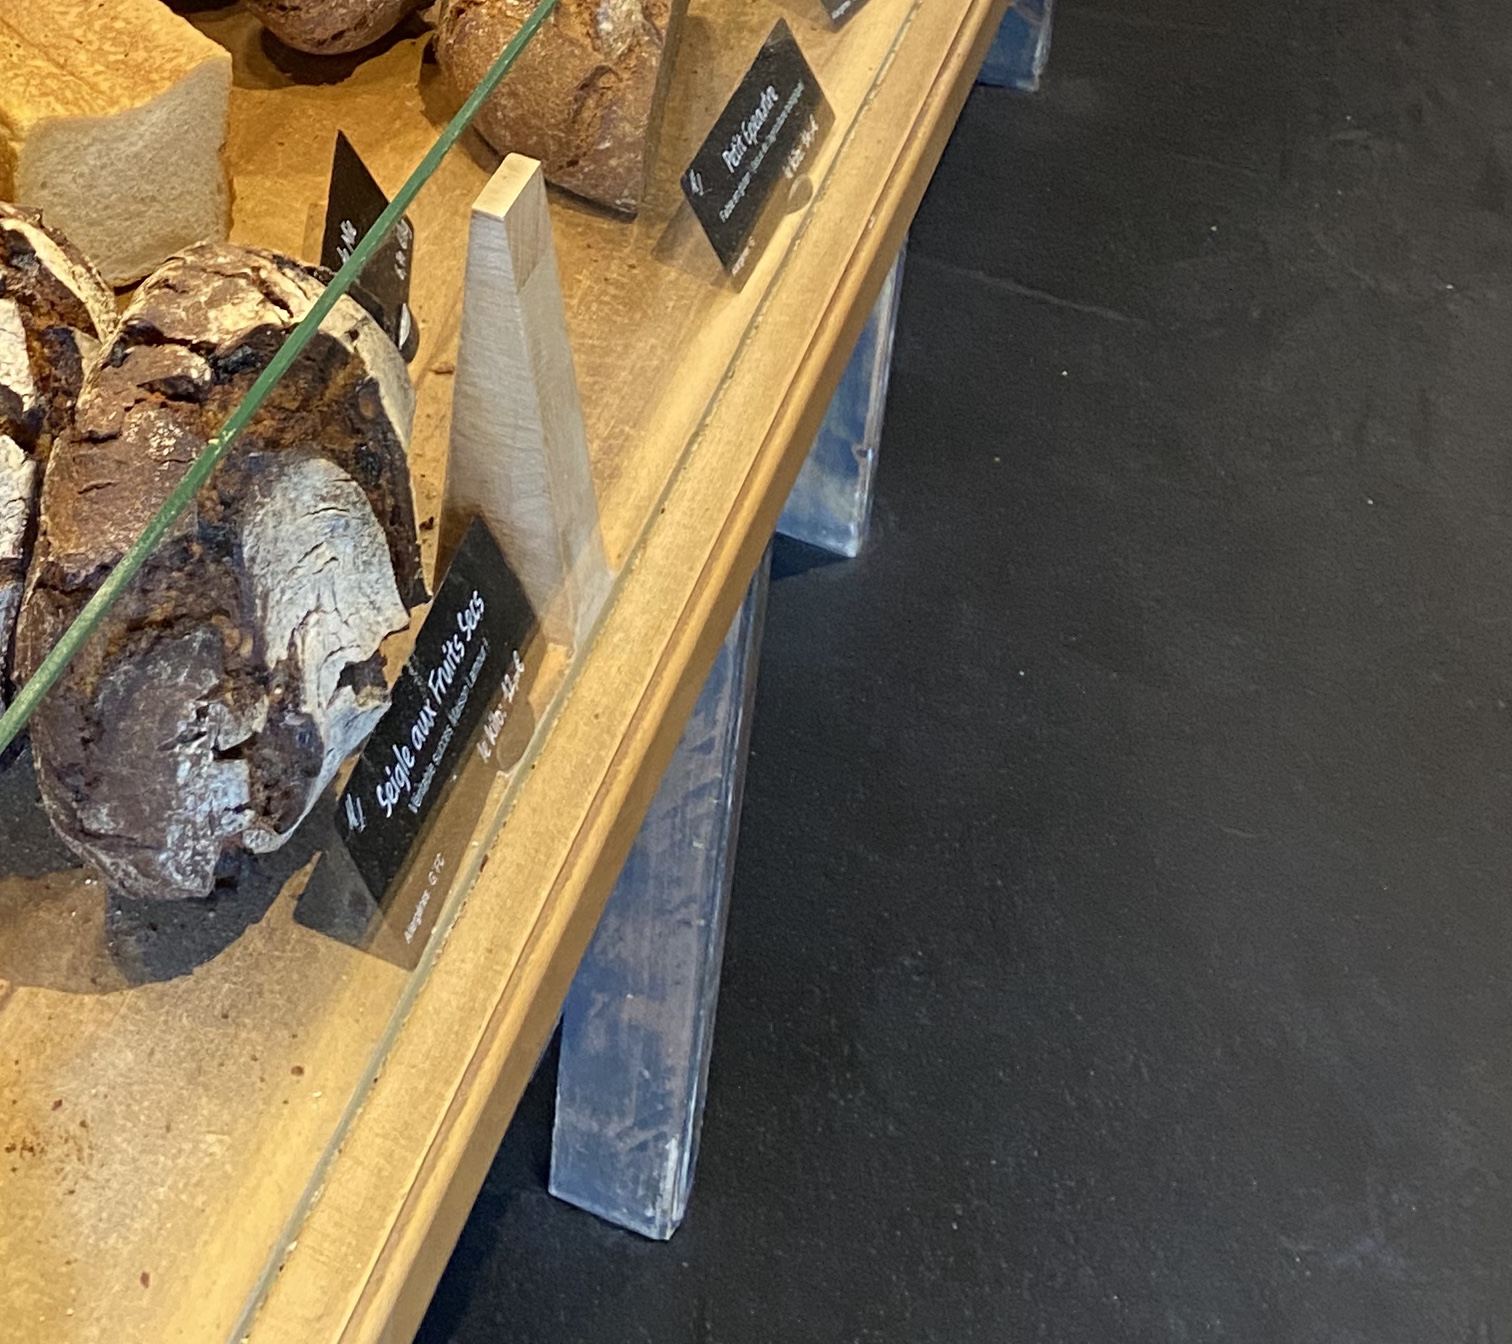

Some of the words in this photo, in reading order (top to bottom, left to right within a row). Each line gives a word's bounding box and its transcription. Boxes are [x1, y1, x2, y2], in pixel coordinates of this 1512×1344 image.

[722, 132, 748, 173] Petit
[464, 645, 487, 689] Lamour
[376, 744, 416, 818] Seigle
[411, 699, 438, 751] aux
[427, 634, 466, 705] Fruits
[456, 590, 485, 642] Secs
